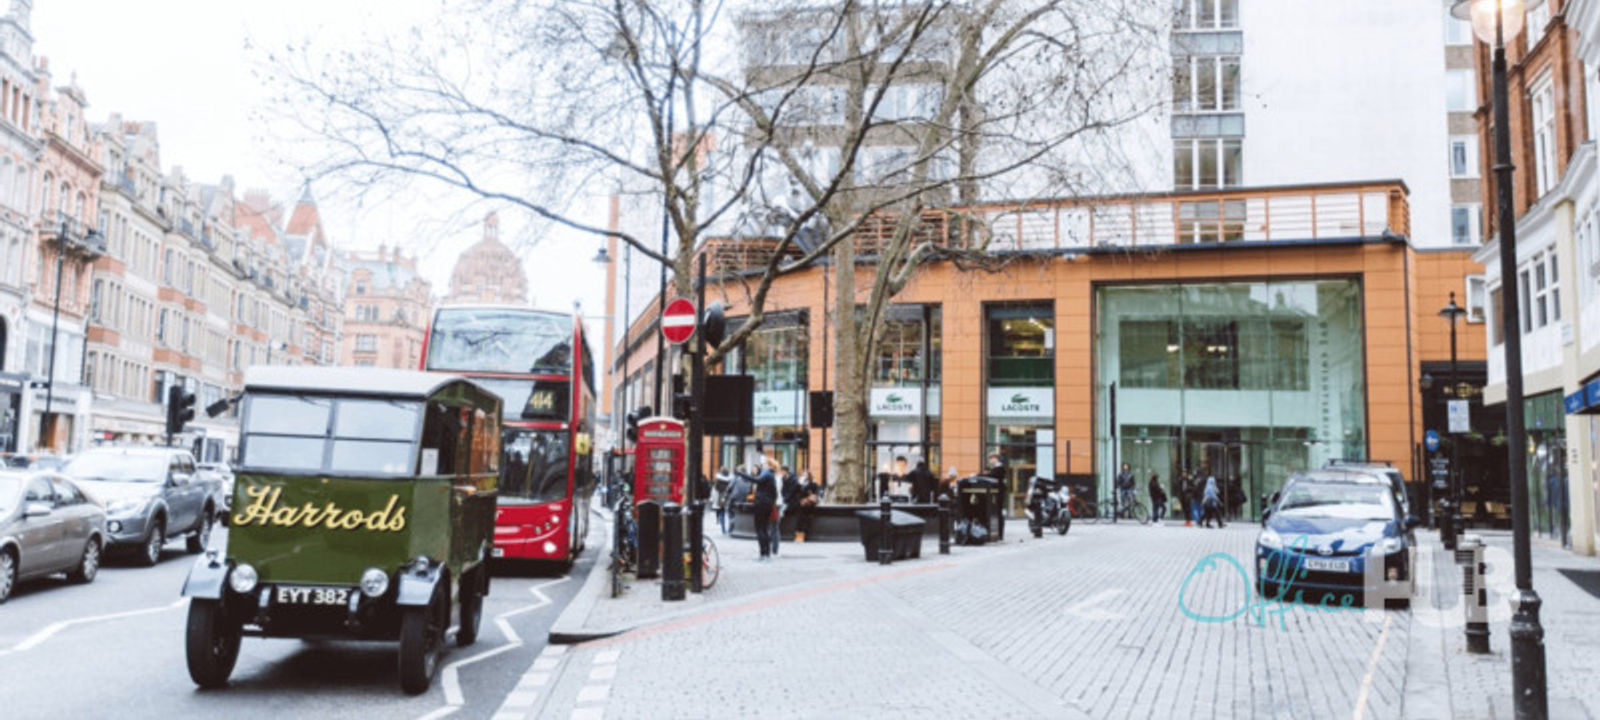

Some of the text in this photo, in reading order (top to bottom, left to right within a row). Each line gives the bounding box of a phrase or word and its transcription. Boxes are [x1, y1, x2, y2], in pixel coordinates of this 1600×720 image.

[530, 391, 553, 409] 414
[876, 403, 913, 412] LACOSTE
[1001, 403, 1040, 412] LACOSTE
[233, 484, 407, 532] Harrods
[277, 587, 348, 605] EYT 382
